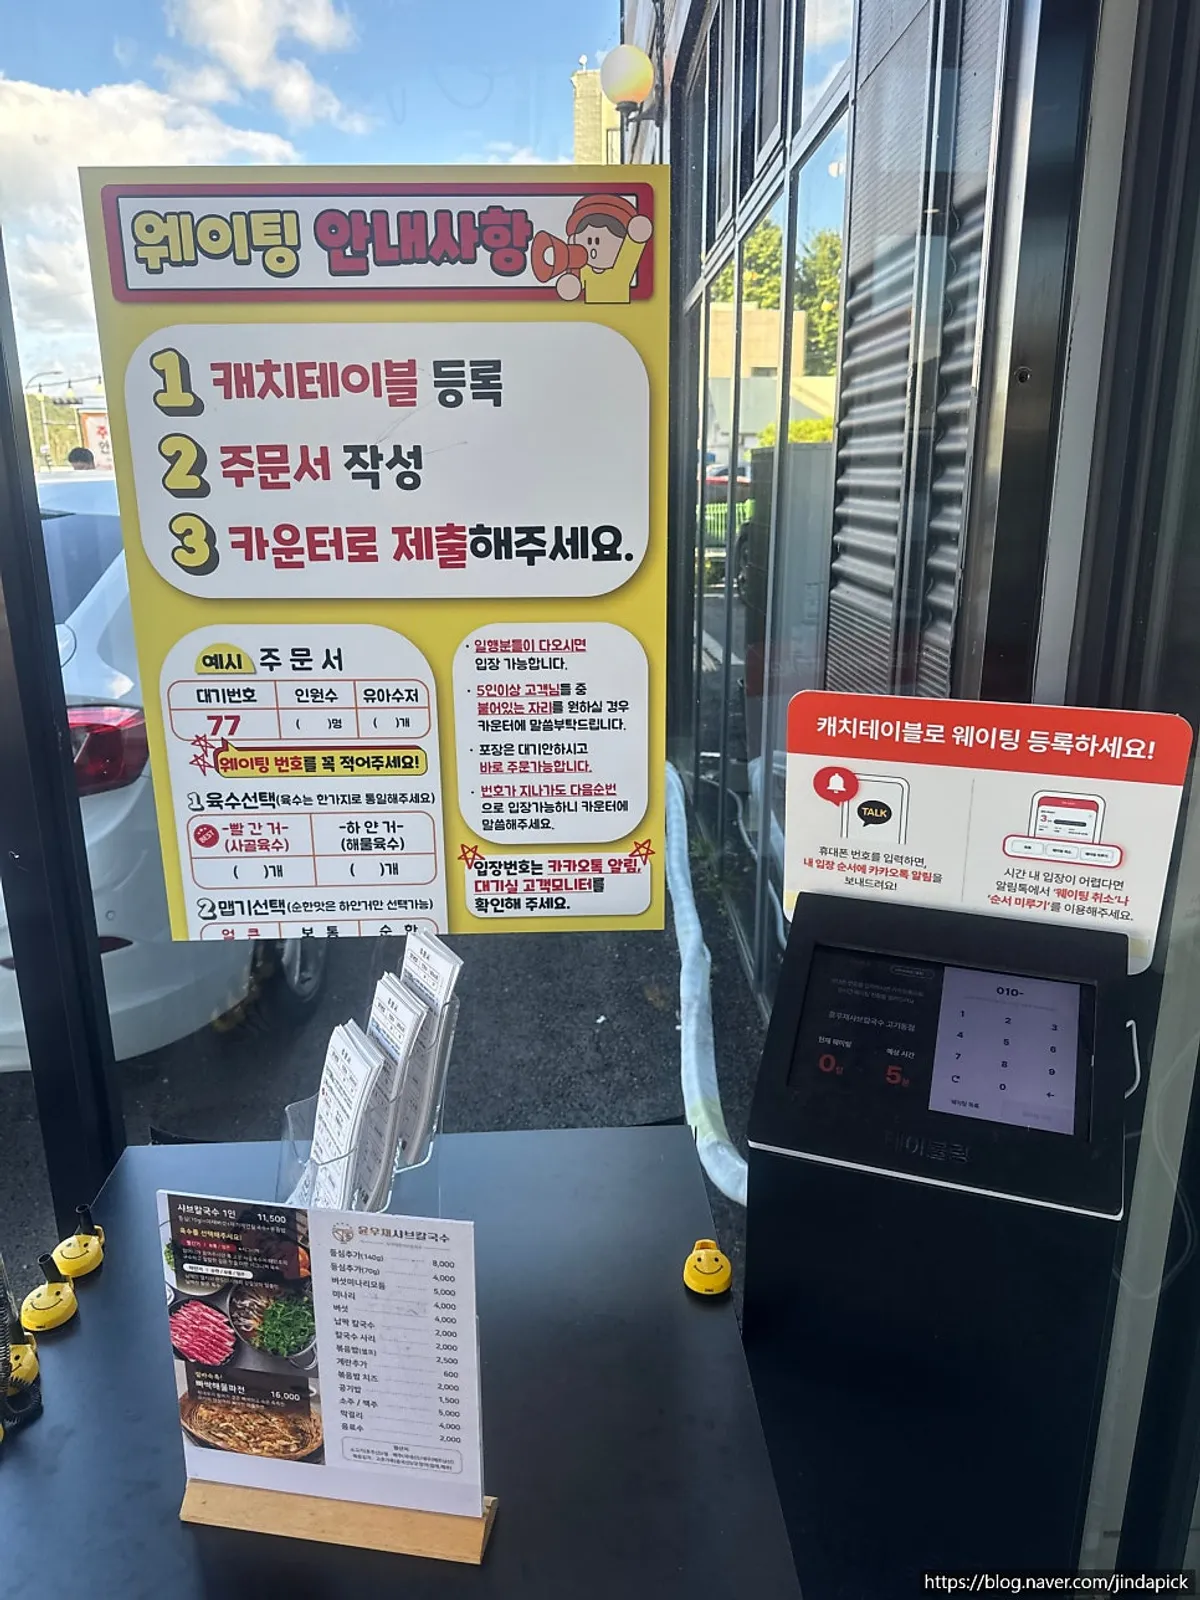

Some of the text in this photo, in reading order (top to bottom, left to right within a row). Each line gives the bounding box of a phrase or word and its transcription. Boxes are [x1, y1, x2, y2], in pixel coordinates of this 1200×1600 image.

[132, 207, 532, 278] 웨이팅 안내사항
[149, 348, 503, 416] 1 캐치테이블 등록
[158, 433, 423, 498] 2 주문서 작성
[170, 512, 634, 576] 3 카운터로 제출해주세요.
[474, 639, 586, 653] 일행분들이 다오시면
[202, 653, 242, 669] 예시
[475, 657, 568, 671] 입장 가능합니다.
[196, 688, 258, 704] 대기번호
[294, 688, 338, 703] 인원수
[363, 687, 419, 704] 유아수저
[477, 683, 587, 697] 5인이상 고객님들 중
[528, 701, 563, 714] 자리를
[568, 700, 602, 714] 원하실
[606, 700, 629, 713] 경우
[206, 716, 241, 736] 77
[478, 718, 627, 733] 카운터에 말씀부탁드립니다.
[816, 716, 1156, 760] 캐치테이블로 웨이팅 등록하세요!
[479, 742, 588, 756] 포장은 대기안하시고
[220, 754, 420, 772] 웨이팅 번호를 꼭 적어주세요!
[480, 760, 592, 774] 바로 주문가능합니다.
[481, 783, 617, 798] 번호가 지나가도 다음순번
[317, 792, 362, 806] 한가지로
[365, 791, 435, 806] 통일해주세요)
[481, 799, 628, 814] 으로 입장가능하니 카운터에
[862, 807, 887, 819] TALK
[482, 817, 555, 831] 말씀해주세요.
[225, 837, 289, 853] (사골육수)
[341, 835, 404, 851] (해물육수)
[819, 846, 928, 870] 휴대폰 번호를 입력하면,
[474, 858, 641, 876] 입장번호는 카카오톡 알림,
[804, 857, 943, 884] 내 입장 순서에 카카오톡 알림을
[474, 877, 605, 894] 대기실 고객모니터를
[844, 876, 897, 892] 보내드려요!
[1004, 868, 1124, 892] 시간 내 입장이 어렵다면
[996, 880, 1050, 897] 알림톡에서
[387, 898, 433, 911] 선택가능)
[475, 896, 570, 913] 확인해 주세요.
[1064, 903, 1134, 922] 이용해주세요.
[996, 986, 1024, 998] 010-
[960, 1010, 965, 1018] 1
[1005, 1016, 1011, 1024] 2
[1004, 1038, 1010, 1046] 5
[1050, 1045, 1056, 1053] 6
[955, 1053, 961, 1061] 7
[1001, 1061, 1007, 1069] 8
[999, 1083, 1006, 1091] 0
[222, 1208, 236, 1220] 1인
[432, 1260, 455, 1268] 8,000
[432, 1274, 455, 1282] 4,000
[433, 1288, 456, 1296] 5,000
[433, 1302, 456, 1310] 4,000
[434, 1316, 457, 1324] 4,000
[435, 1330, 457, 1338] 2,000
[436, 1343, 458, 1351] 2,000
[436, 1356, 458, 1365] 2,500
[438, 1383, 459, 1391] 2,000
[439, 1396, 460, 1405] 1,500
[439, 1409, 460, 1418] 5,000
[439, 1422, 461, 1431] 4,000
[439, 1435, 462, 1444] 2,000
